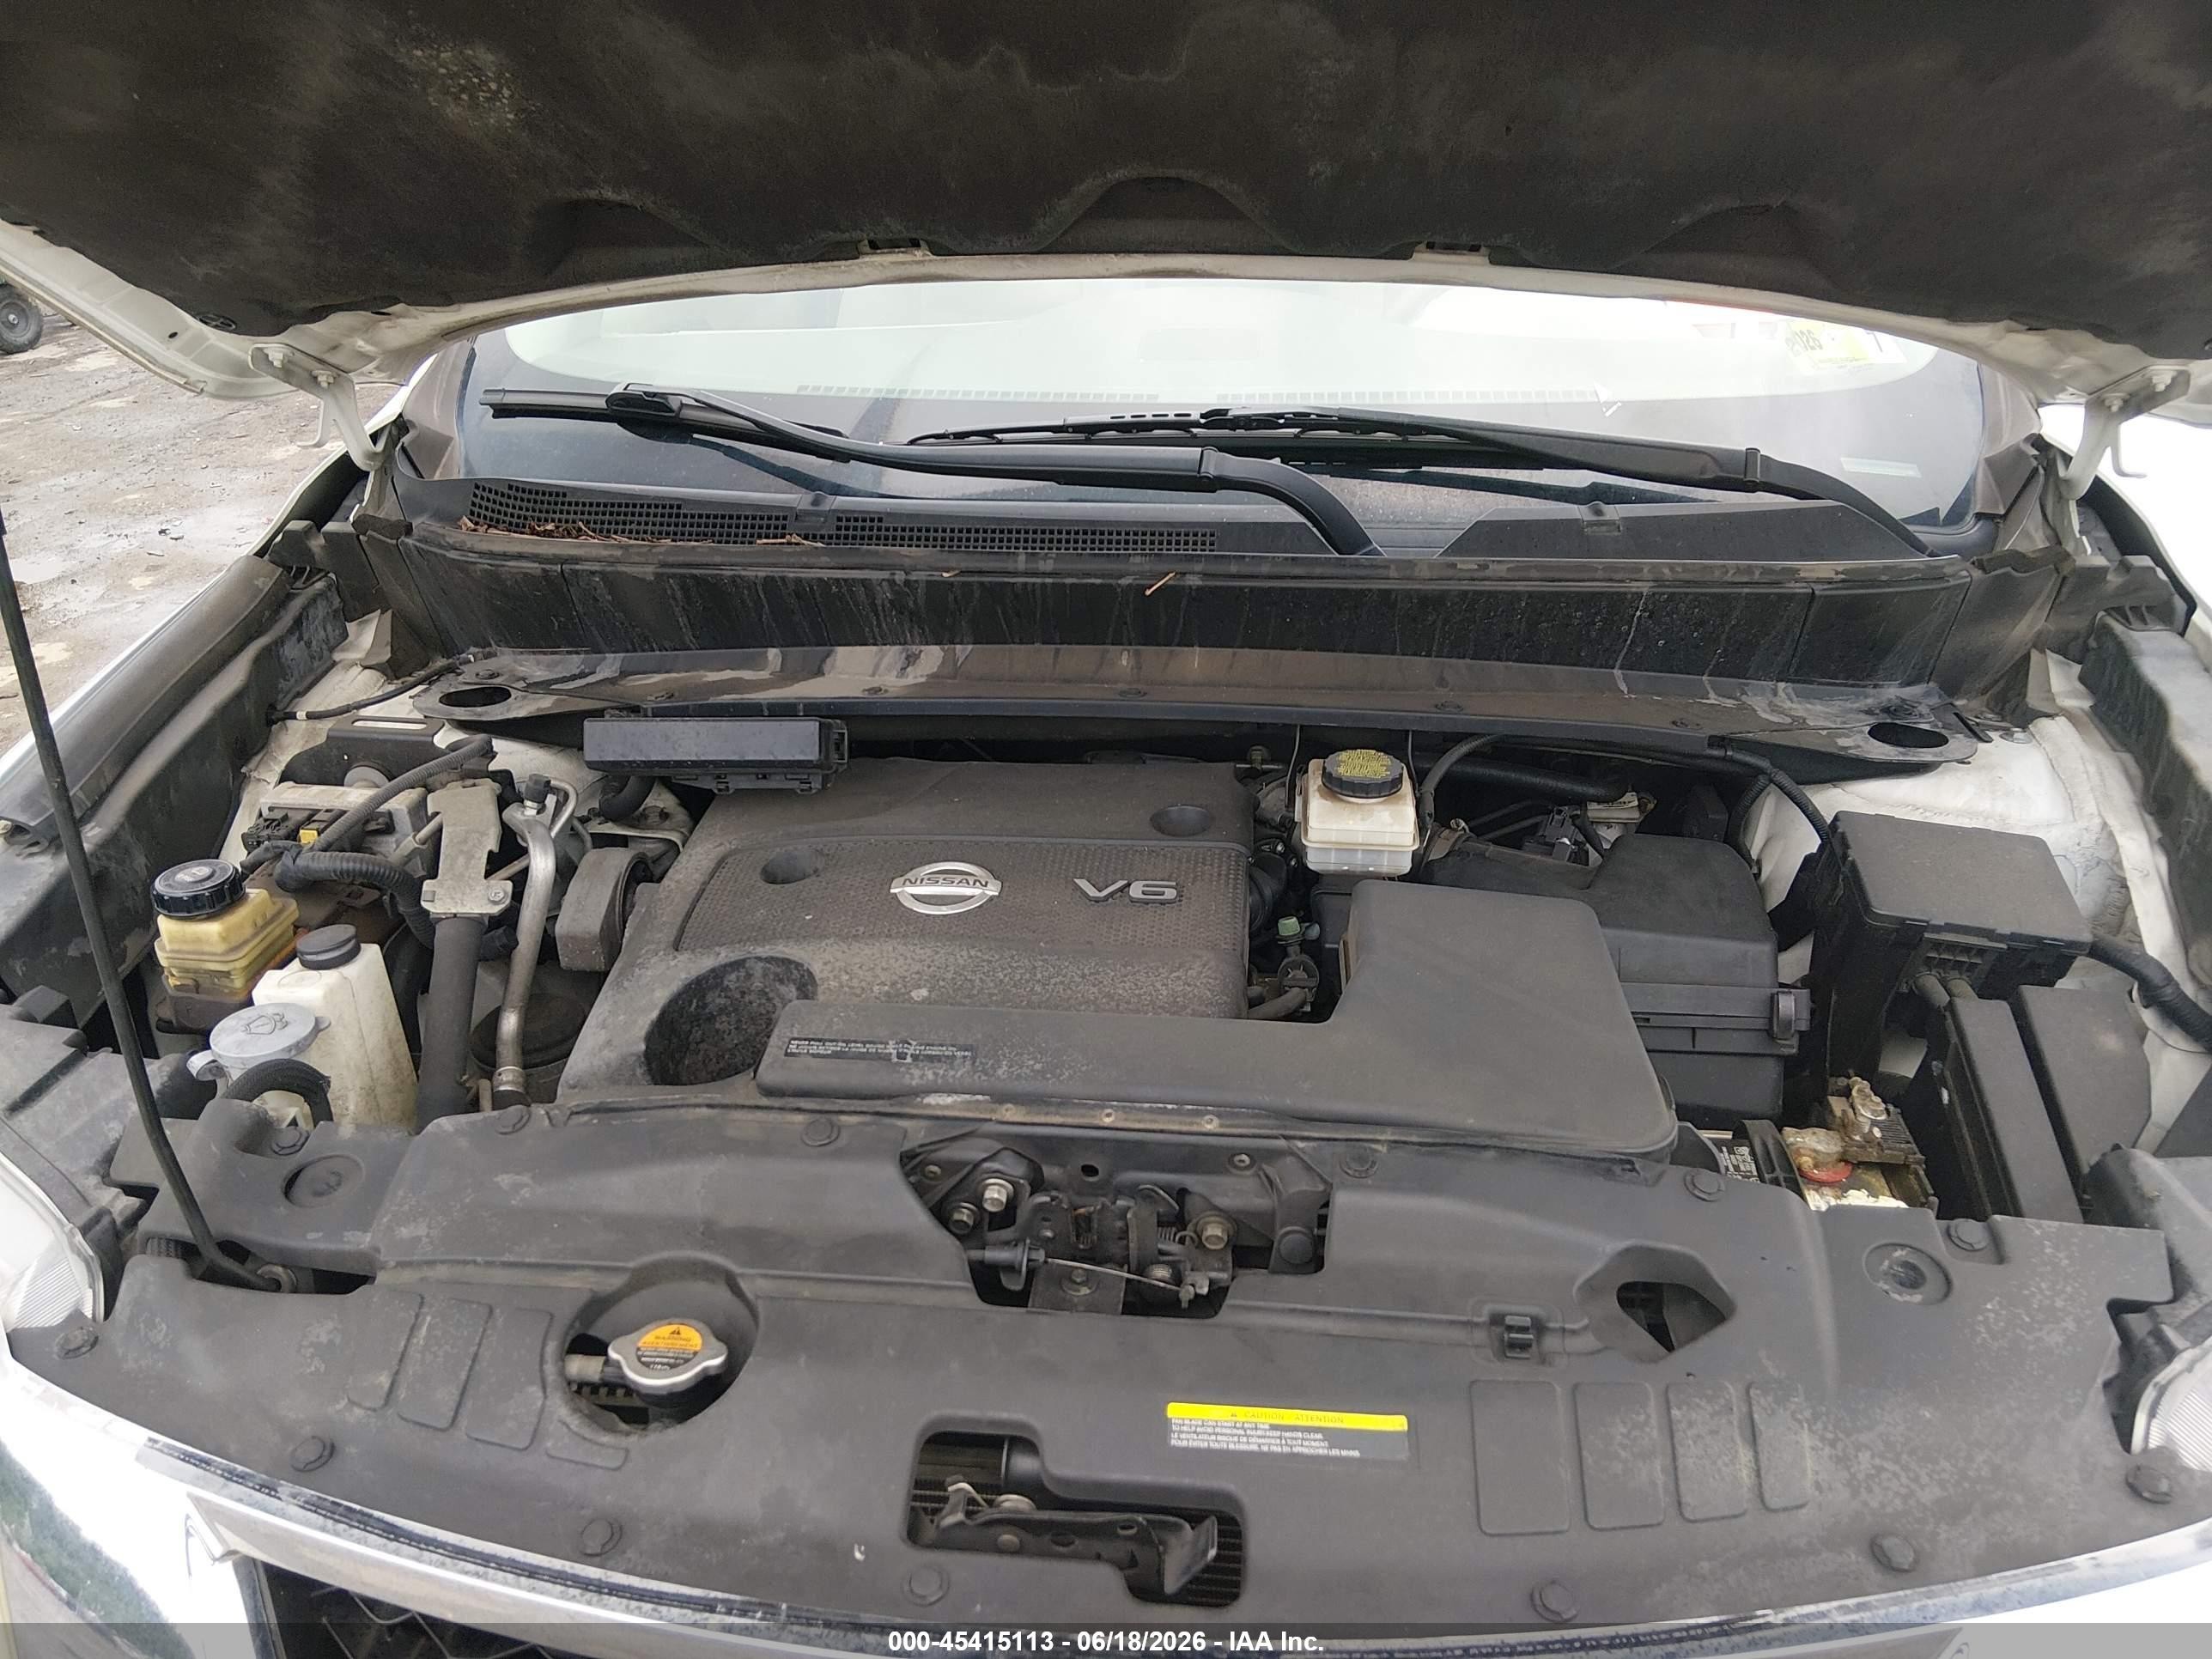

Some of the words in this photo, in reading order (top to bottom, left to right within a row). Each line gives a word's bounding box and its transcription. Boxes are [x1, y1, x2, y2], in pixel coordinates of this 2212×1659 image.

[902, 877, 989, 888] NISSAN
[1073, 878, 1177, 902] V6
[1244, 1411, 1285, 1420] CAUTION
[1294, 1414, 1344, 1425] ATTENTION
